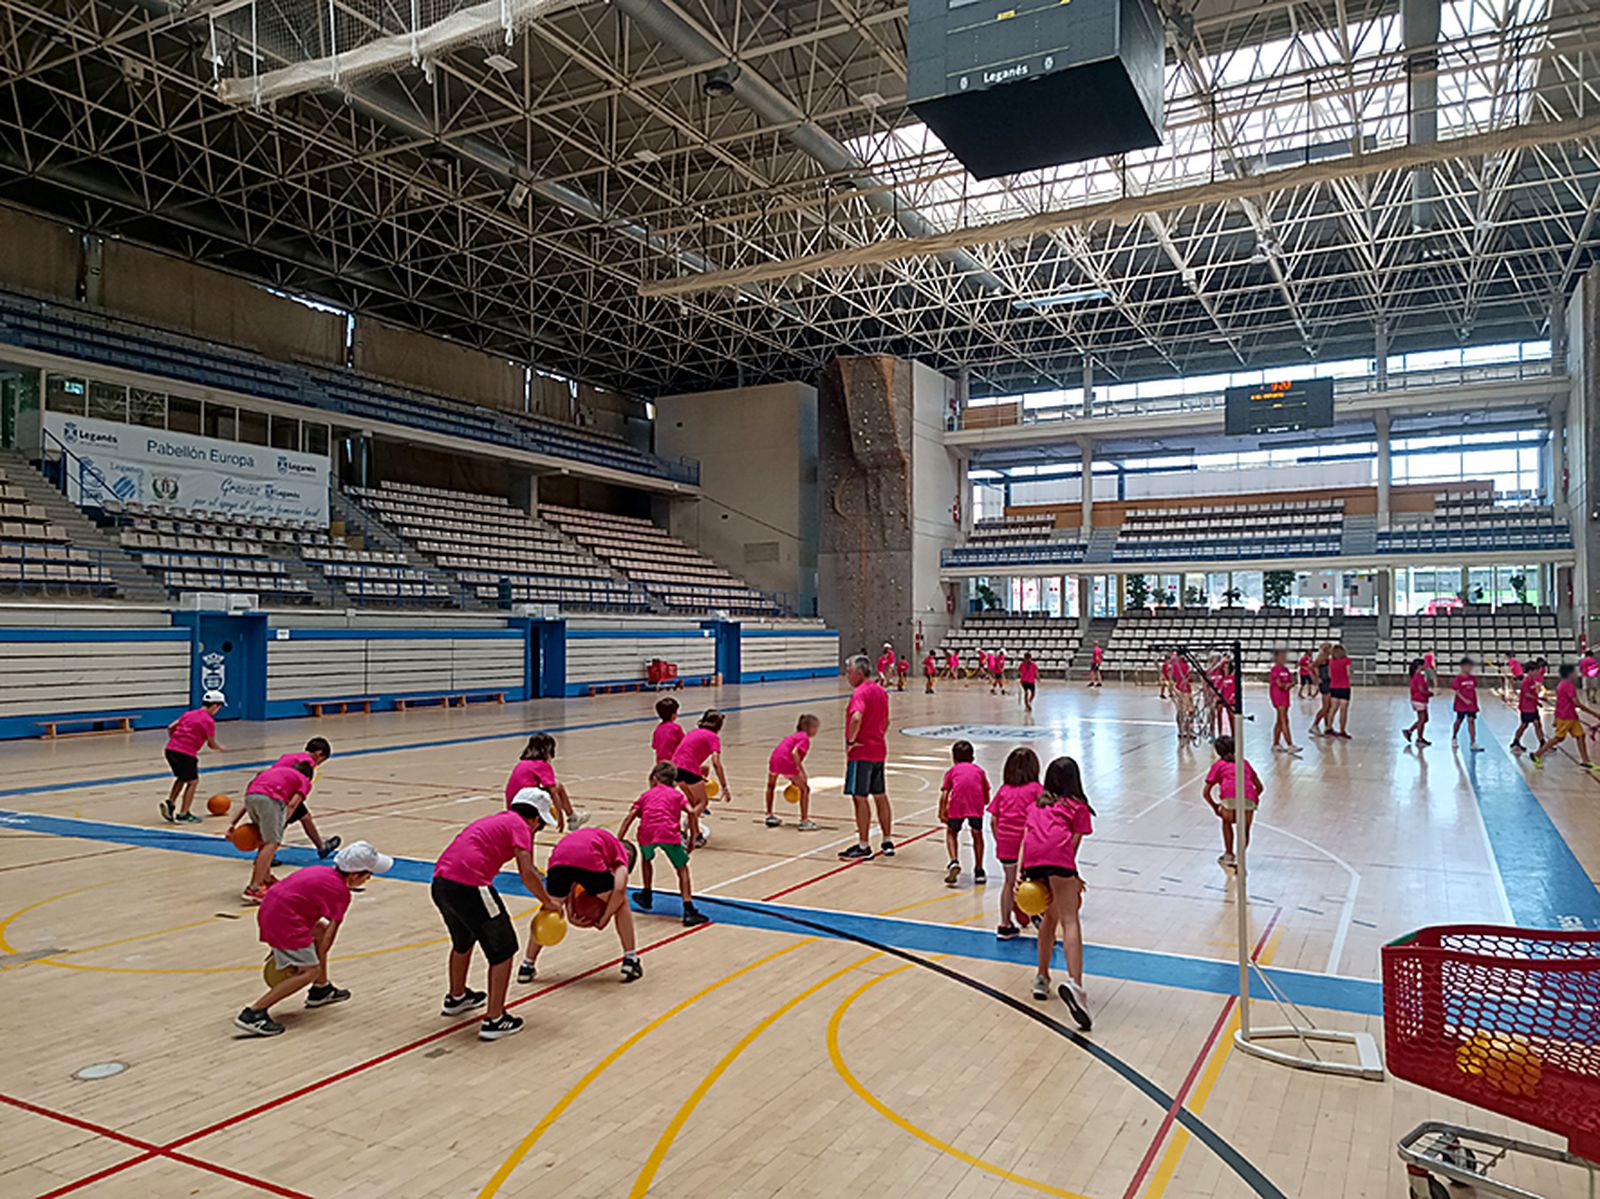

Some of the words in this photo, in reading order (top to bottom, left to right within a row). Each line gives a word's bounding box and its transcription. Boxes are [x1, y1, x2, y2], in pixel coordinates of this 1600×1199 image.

[983, 64, 1028, 83] Leganés
[79, 430, 118, 443] Leganés
[147, 440, 206, 460] Pabellón
[210, 449, 255, 468] Europa
